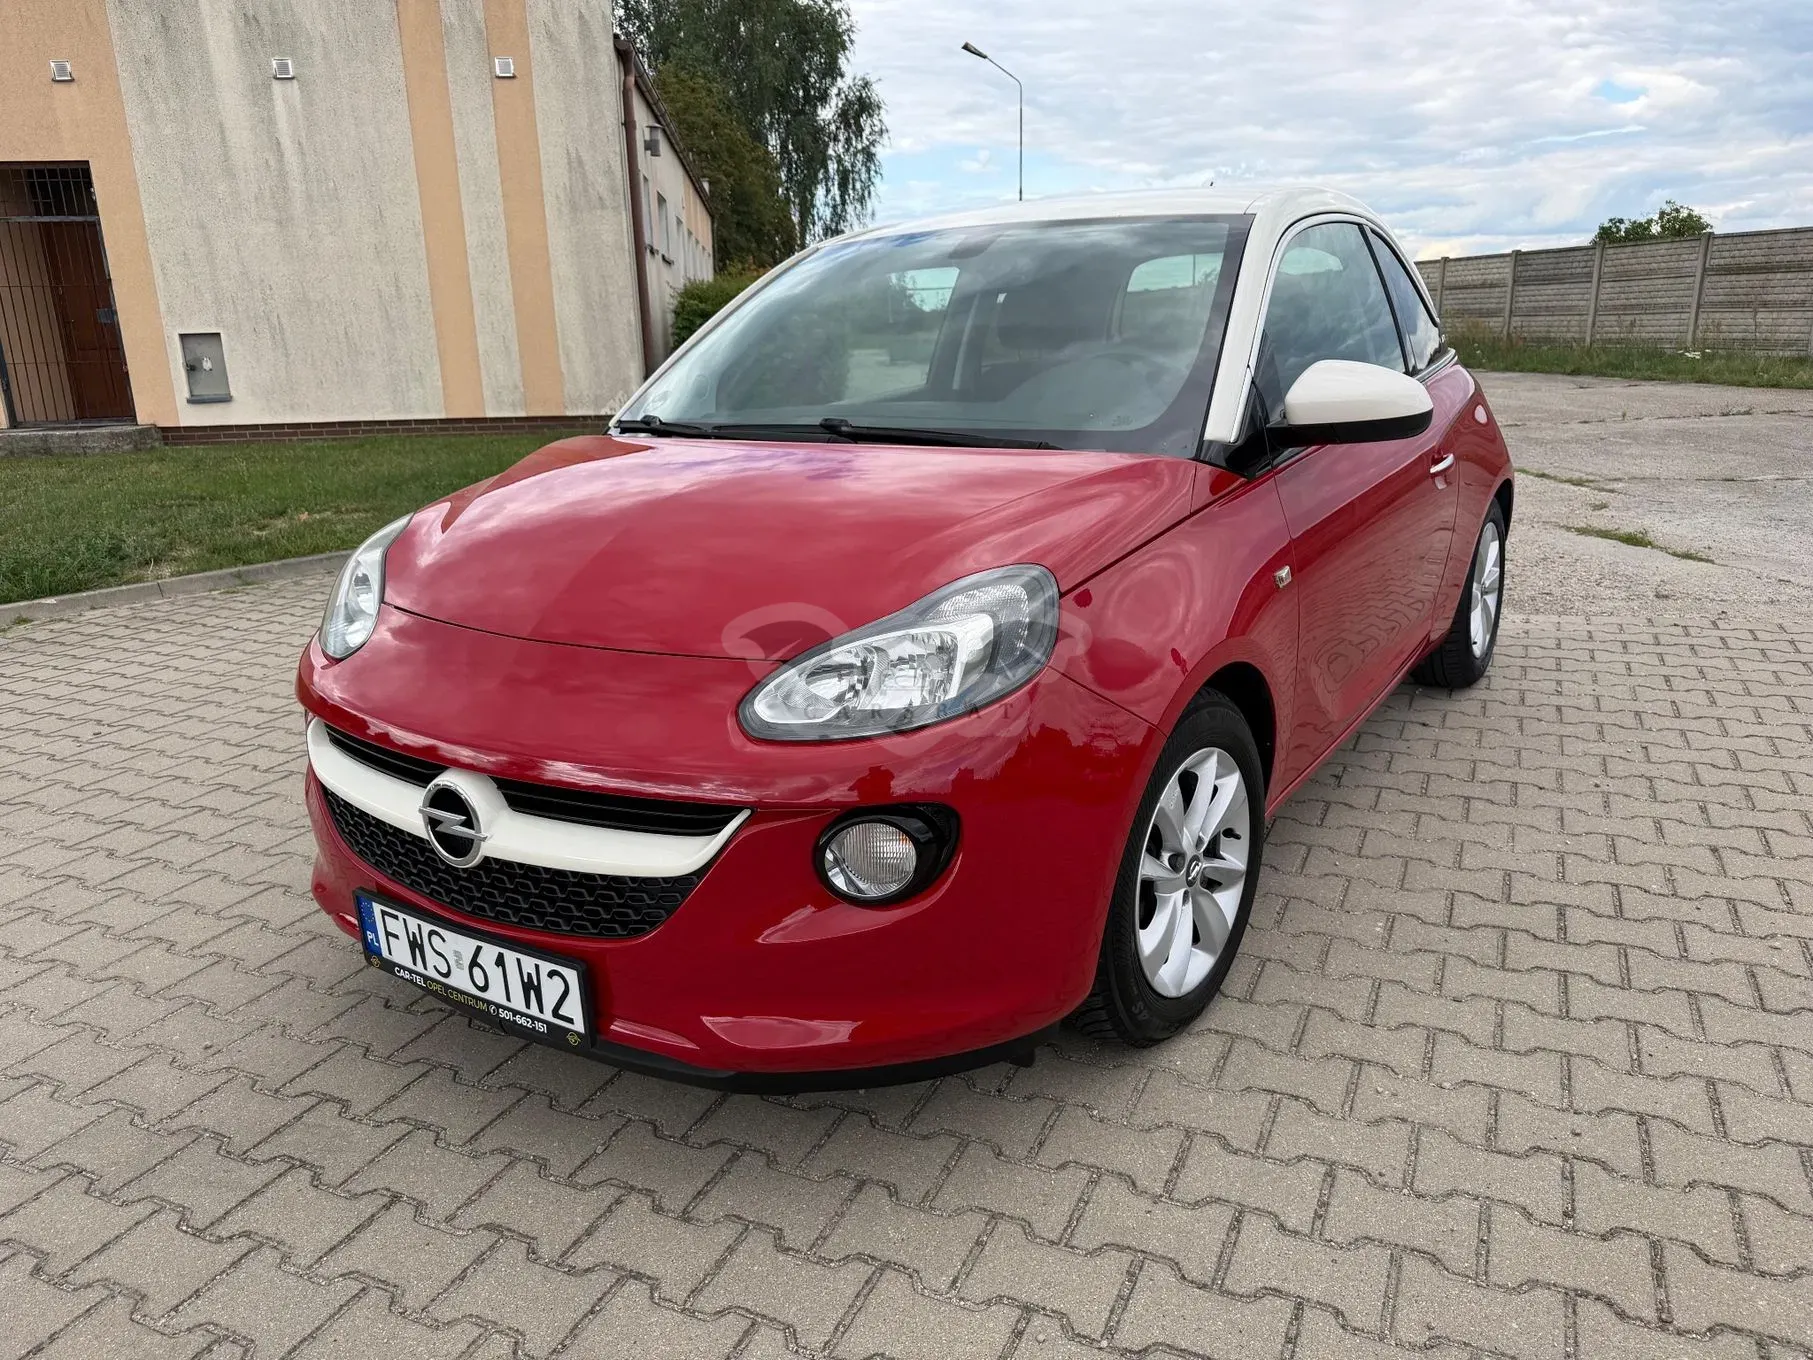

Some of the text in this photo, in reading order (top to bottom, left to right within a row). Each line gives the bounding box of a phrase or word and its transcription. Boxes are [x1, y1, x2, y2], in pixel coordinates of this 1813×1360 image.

[366, 931, 380, 946] PL
[380, 908, 575, 1026] FWS 61W2
[394, 966, 548, 1034] CAR-TEL OPEL CENTRUM 501-662-151
